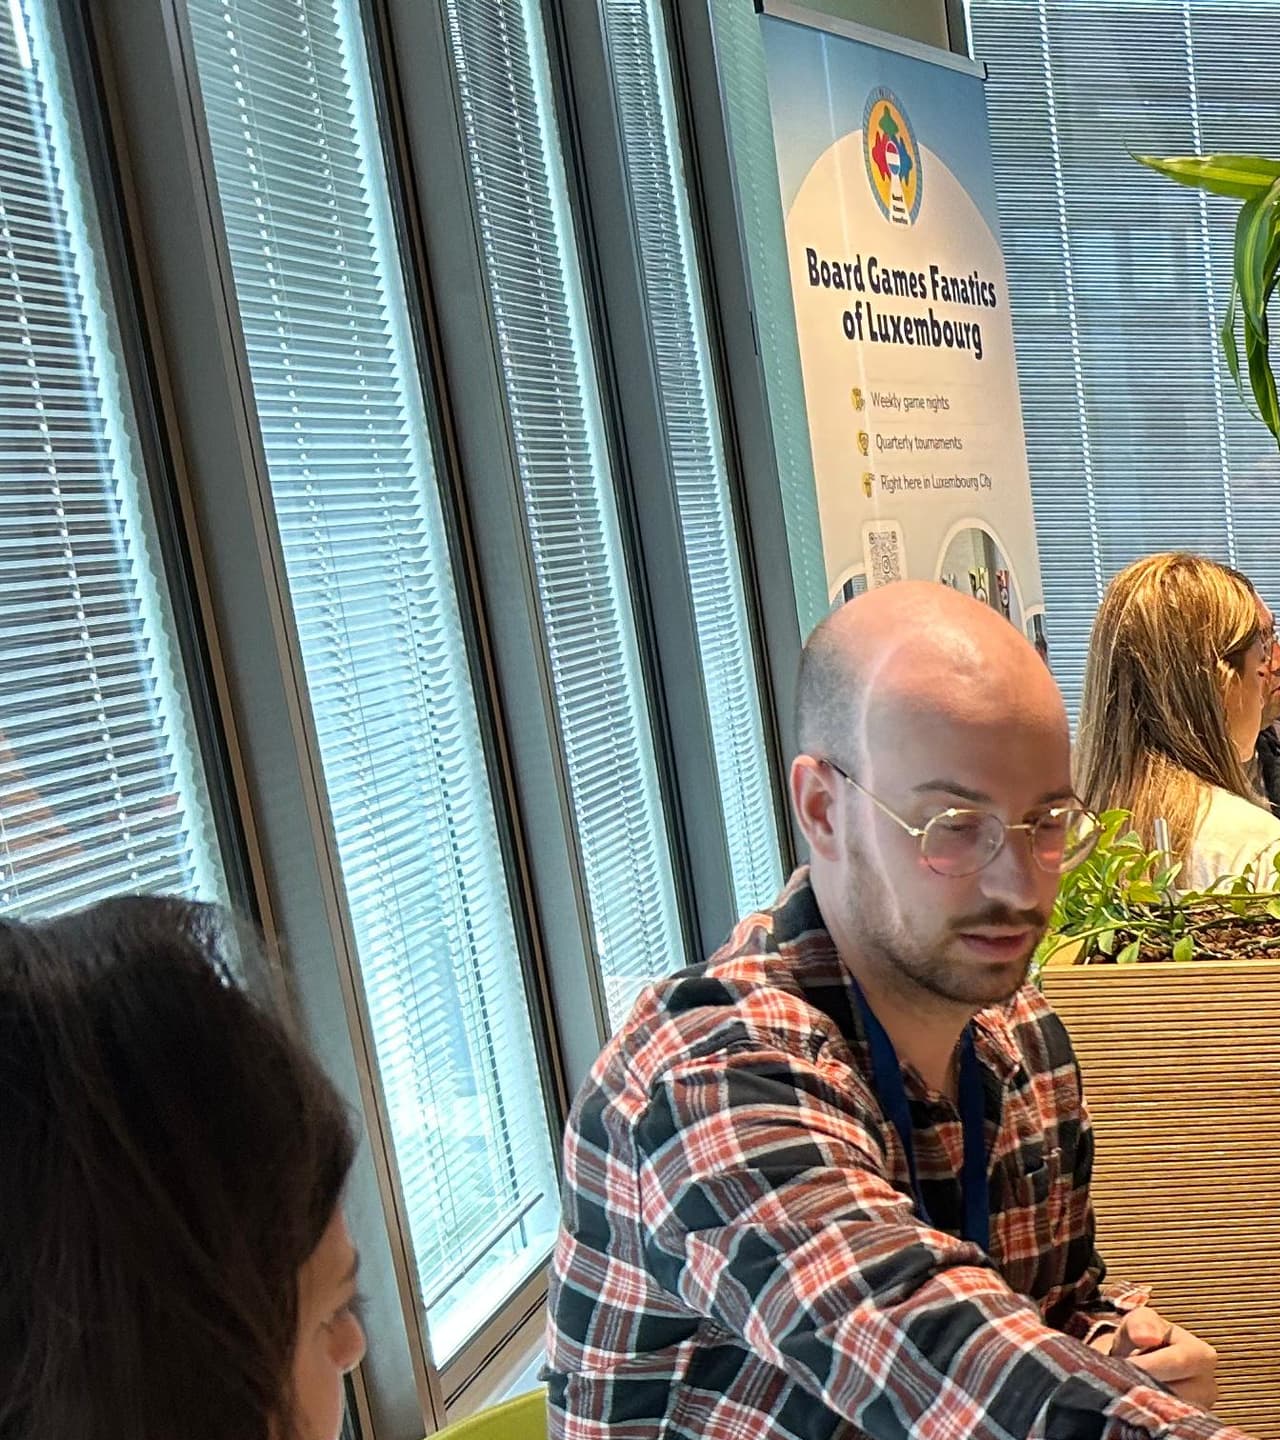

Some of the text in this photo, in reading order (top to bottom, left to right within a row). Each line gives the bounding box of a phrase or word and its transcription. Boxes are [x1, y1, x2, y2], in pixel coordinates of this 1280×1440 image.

[806, 247, 997, 308] Board Games Fanatics
[843, 301, 983, 360] of Luxembourg
[870, 391, 950, 413] Weekly game nights
[876, 433, 963, 452] Quarterly tournaments
[881, 474, 903, 494] Right
[903, 474, 922, 489] here
[932, 472, 979, 491] Luxembourg
